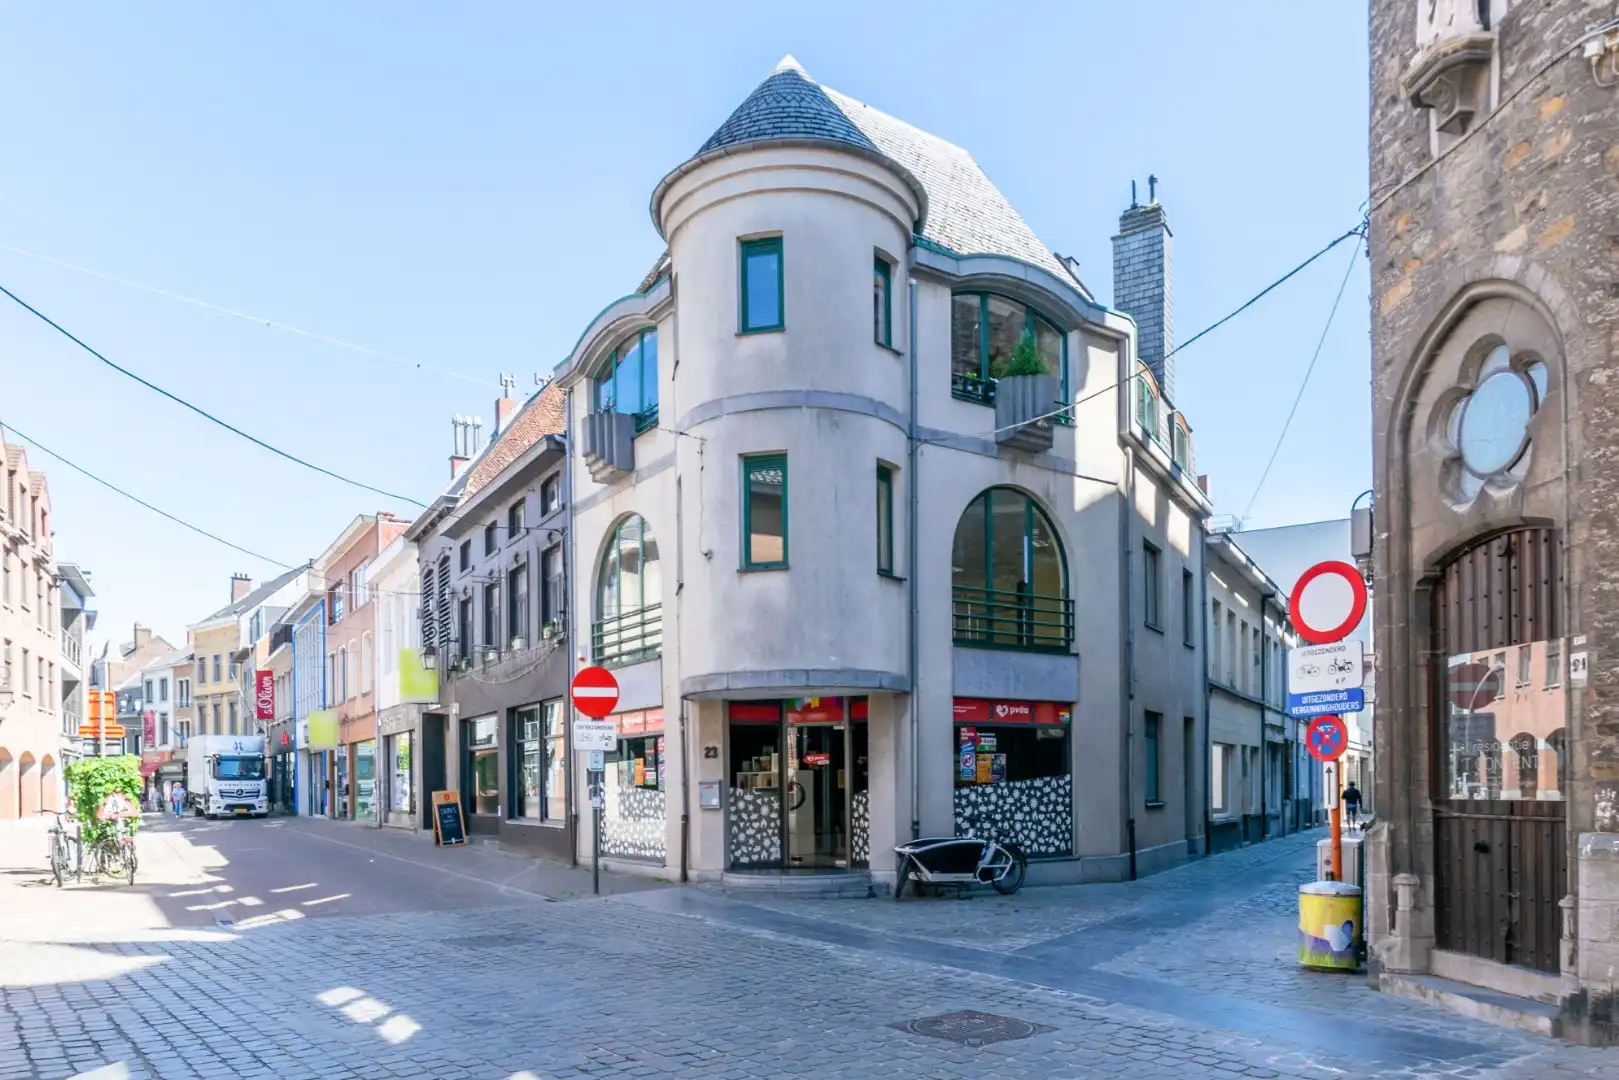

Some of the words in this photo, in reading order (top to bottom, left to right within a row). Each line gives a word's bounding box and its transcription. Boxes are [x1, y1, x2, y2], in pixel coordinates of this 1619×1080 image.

[1301, 645, 1346, 657] UITGEZONDERD
[1301, 692, 1348, 705] UITGEZONDERD
[1009, 706, 1029, 716] pvda
[1291, 701, 1360, 715] VERGUNNINGHOUDERS
[704, 746, 718, 759] 23
